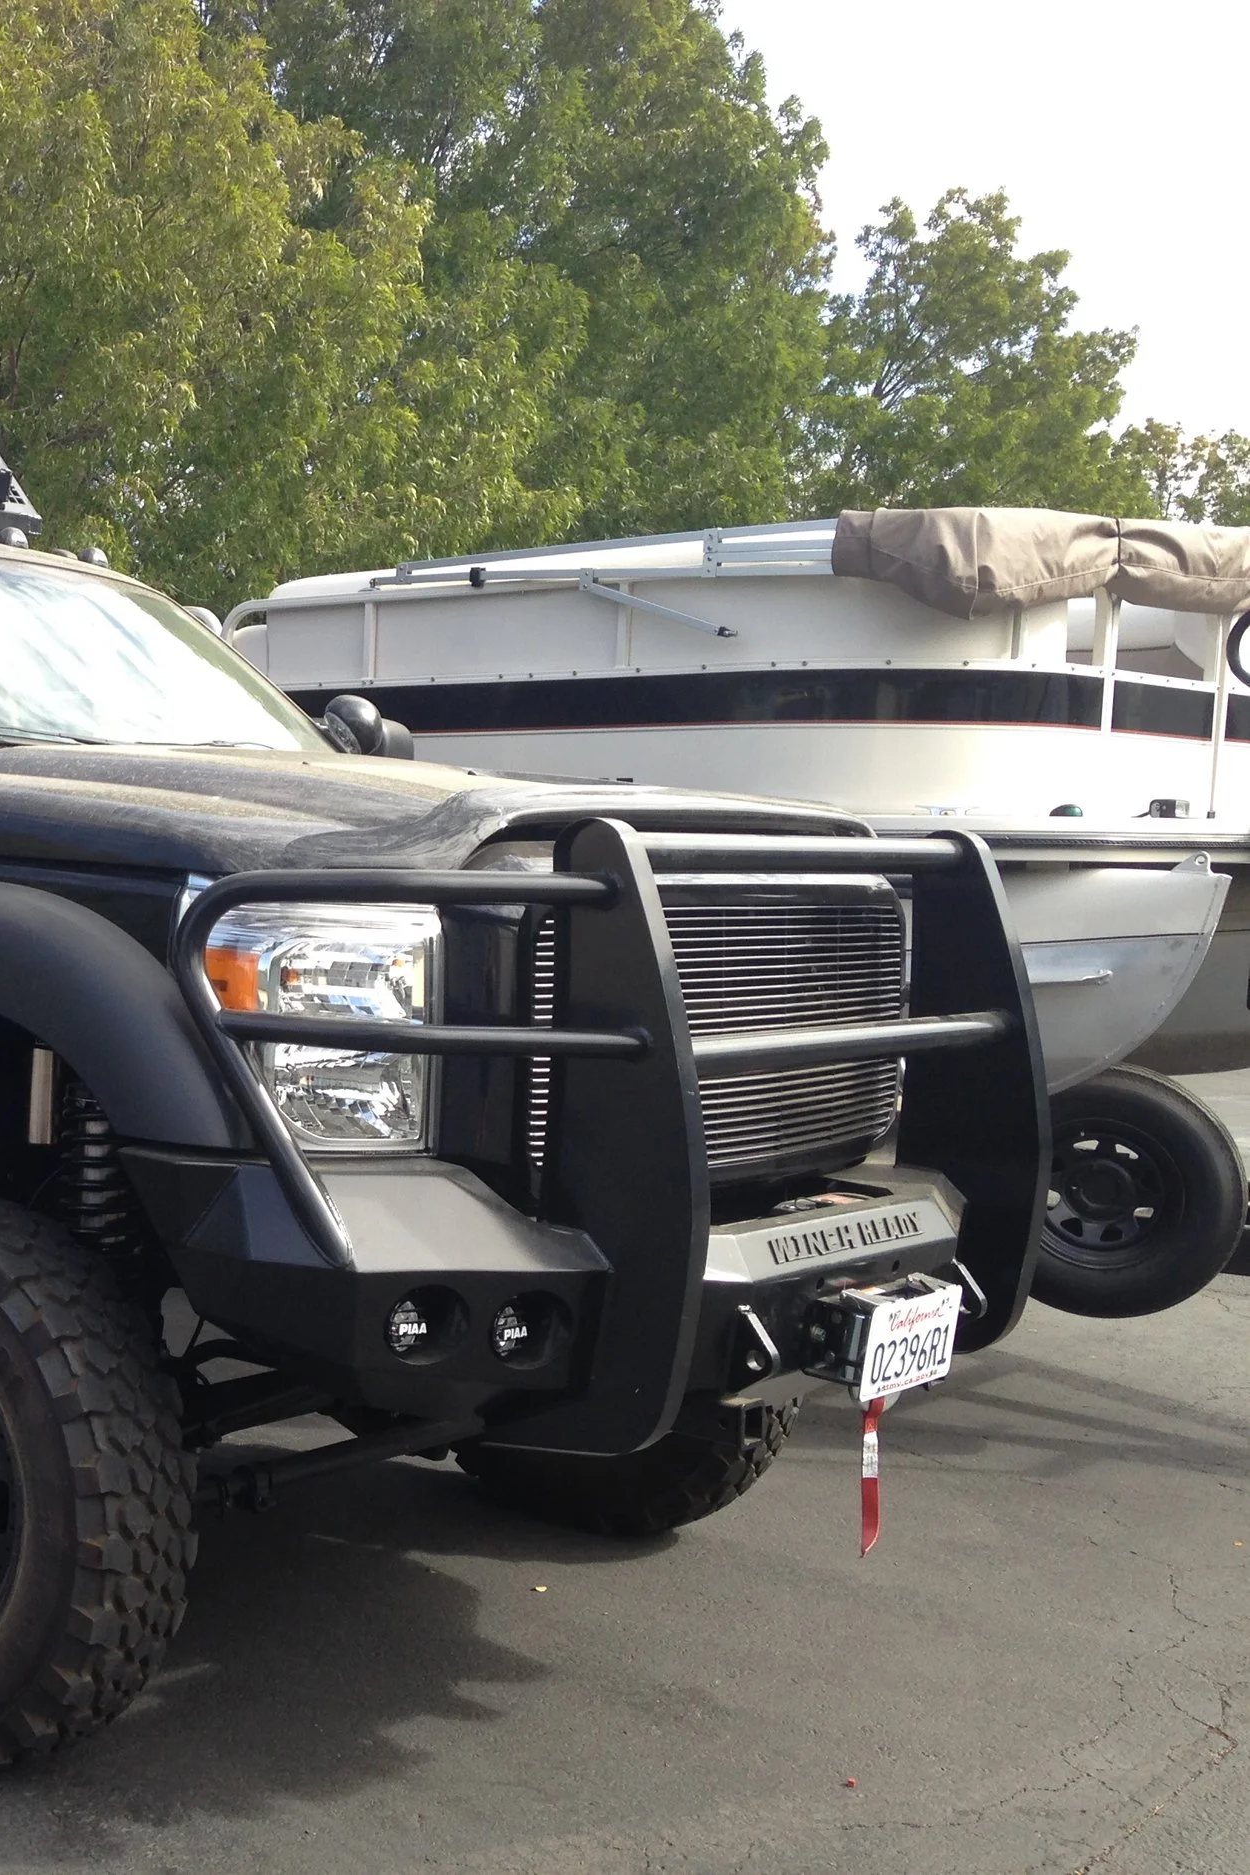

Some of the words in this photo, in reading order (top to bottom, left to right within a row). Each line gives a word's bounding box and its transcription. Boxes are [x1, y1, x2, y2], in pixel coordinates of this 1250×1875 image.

[857, 1211, 924, 1246] READY
[399, 1322, 427, 1336] PIAA
[890, 1306, 944, 1332] California
[503, 1326, 528, 1341] PIAA
[871, 1324, 949, 1385] 02396R1
